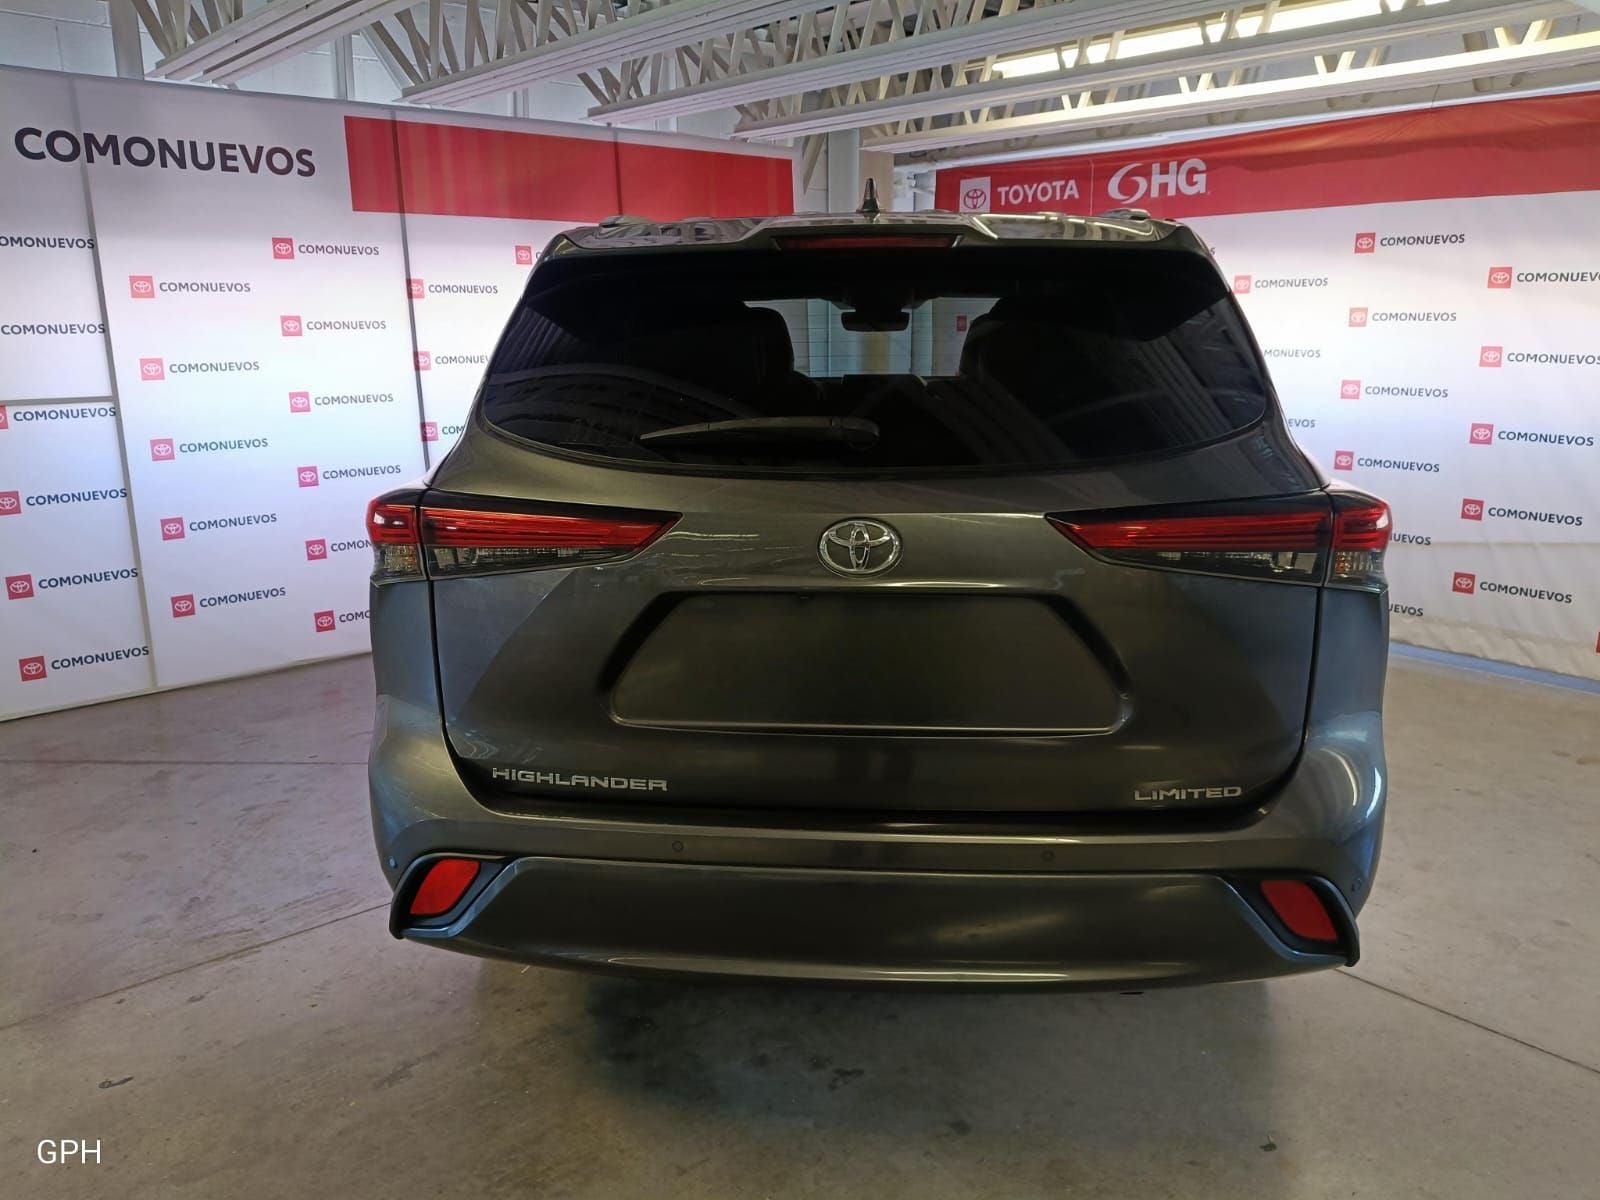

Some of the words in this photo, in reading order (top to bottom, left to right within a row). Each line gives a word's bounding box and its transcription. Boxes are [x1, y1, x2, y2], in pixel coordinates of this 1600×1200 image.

[14, 126, 316, 178] COMONUEVOS
[997, 179, 1080, 206] TOYOTA
[0, 235, 95, 249] OMONUEVOS
[1379, 233, 1465, 247] COMONUEVOS
[297, 244, 380, 256] COMONUEVOS
[1254, 277, 1329, 289] COMONUEVOS
[1516, 271, 1600, 283] COMONUEV
[159, 281, 251, 293] COMONUEVOS
[428, 284, 499, 294] COMONUEVOS
[1371, 311, 1457, 322] COMONUEVOS
[0, 322, 106, 336] COMONUEVOS
[306, 320, 387, 331] COMONUEVOS
[434, 354, 489, 365] COMONUE
[1263, 348, 1321, 359] MONUEVOS
[168, 361, 260, 374] COMONUEVOS
[314, 393, 394, 406] COMONUEVOS
[1364, 386, 1449, 399] COMONUEVOS
[13, 406, 116, 422] COMONUEVOS
[179, 437, 269, 454] COMONUEVOS
[1497, 430, 1594, 447] COMONUEVOS
[322, 464, 402, 480] COMONUEVOS
[1357, 457, 1440, 473] COMONUEVOS
[25, 487, 128, 506] COMONUEVOS
[189, 513, 278, 532] COMONUEVOS
[1487, 507, 1583, 527] COMONUEVOS
[1390, 531, 1432, 546] UEVOS
[38, 567, 139, 590] COMONUEVOS
[199, 586, 287, 608] COMONUEVOS
[1479, 581, 1573, 604] COMONUEVOS
[1388, 602, 1424, 617] UEVOS
[50, 645, 150, 671] COMONUEVOS
[492, 767, 668, 792] HIGHLANDER
[1134, 784, 1242, 801] LIMITED
